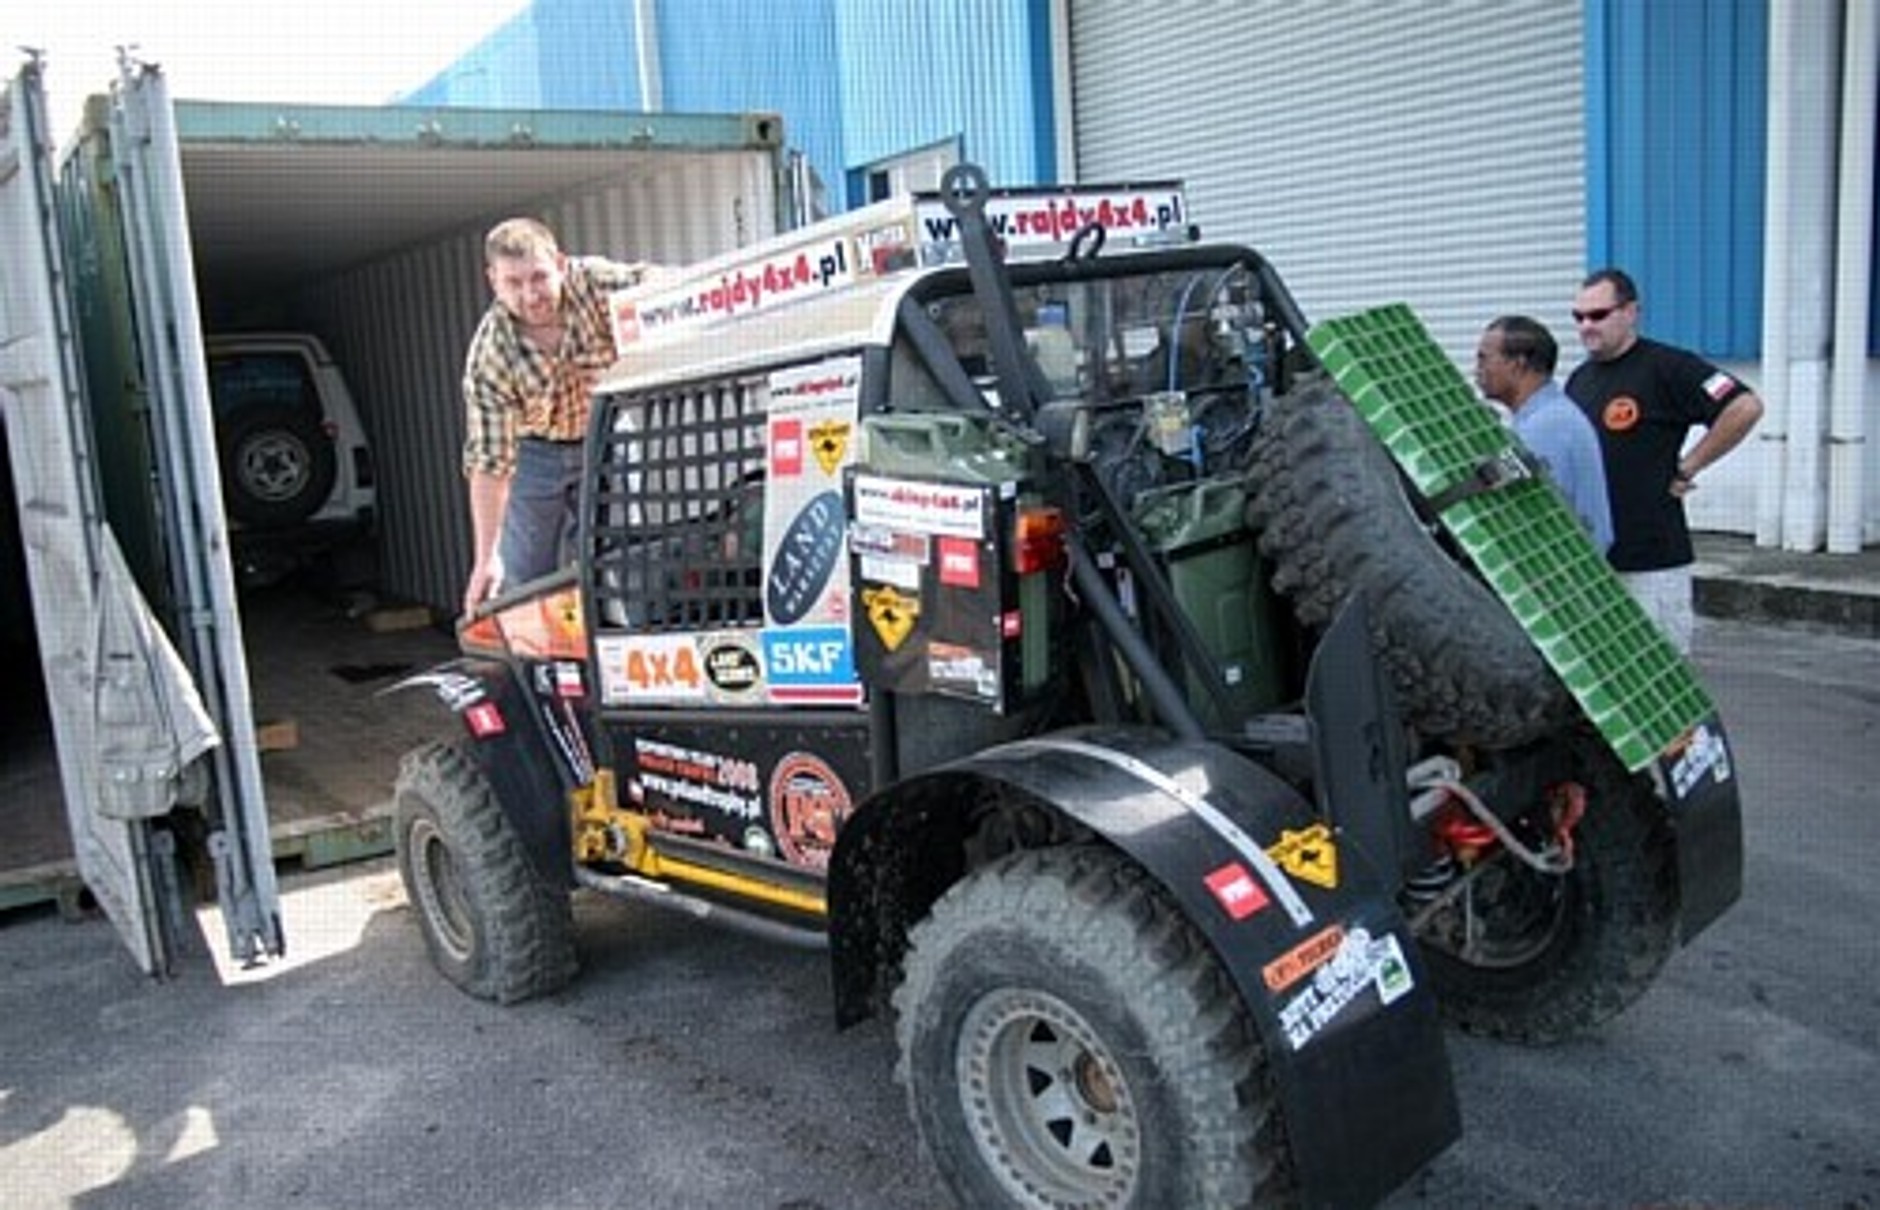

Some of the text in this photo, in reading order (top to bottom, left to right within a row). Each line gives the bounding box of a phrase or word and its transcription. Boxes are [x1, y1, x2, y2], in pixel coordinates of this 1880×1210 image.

[771, 501, 829, 596] LAND
[627, 645, 699, 689] 4x4
[770, 641, 844, 675] SKF
